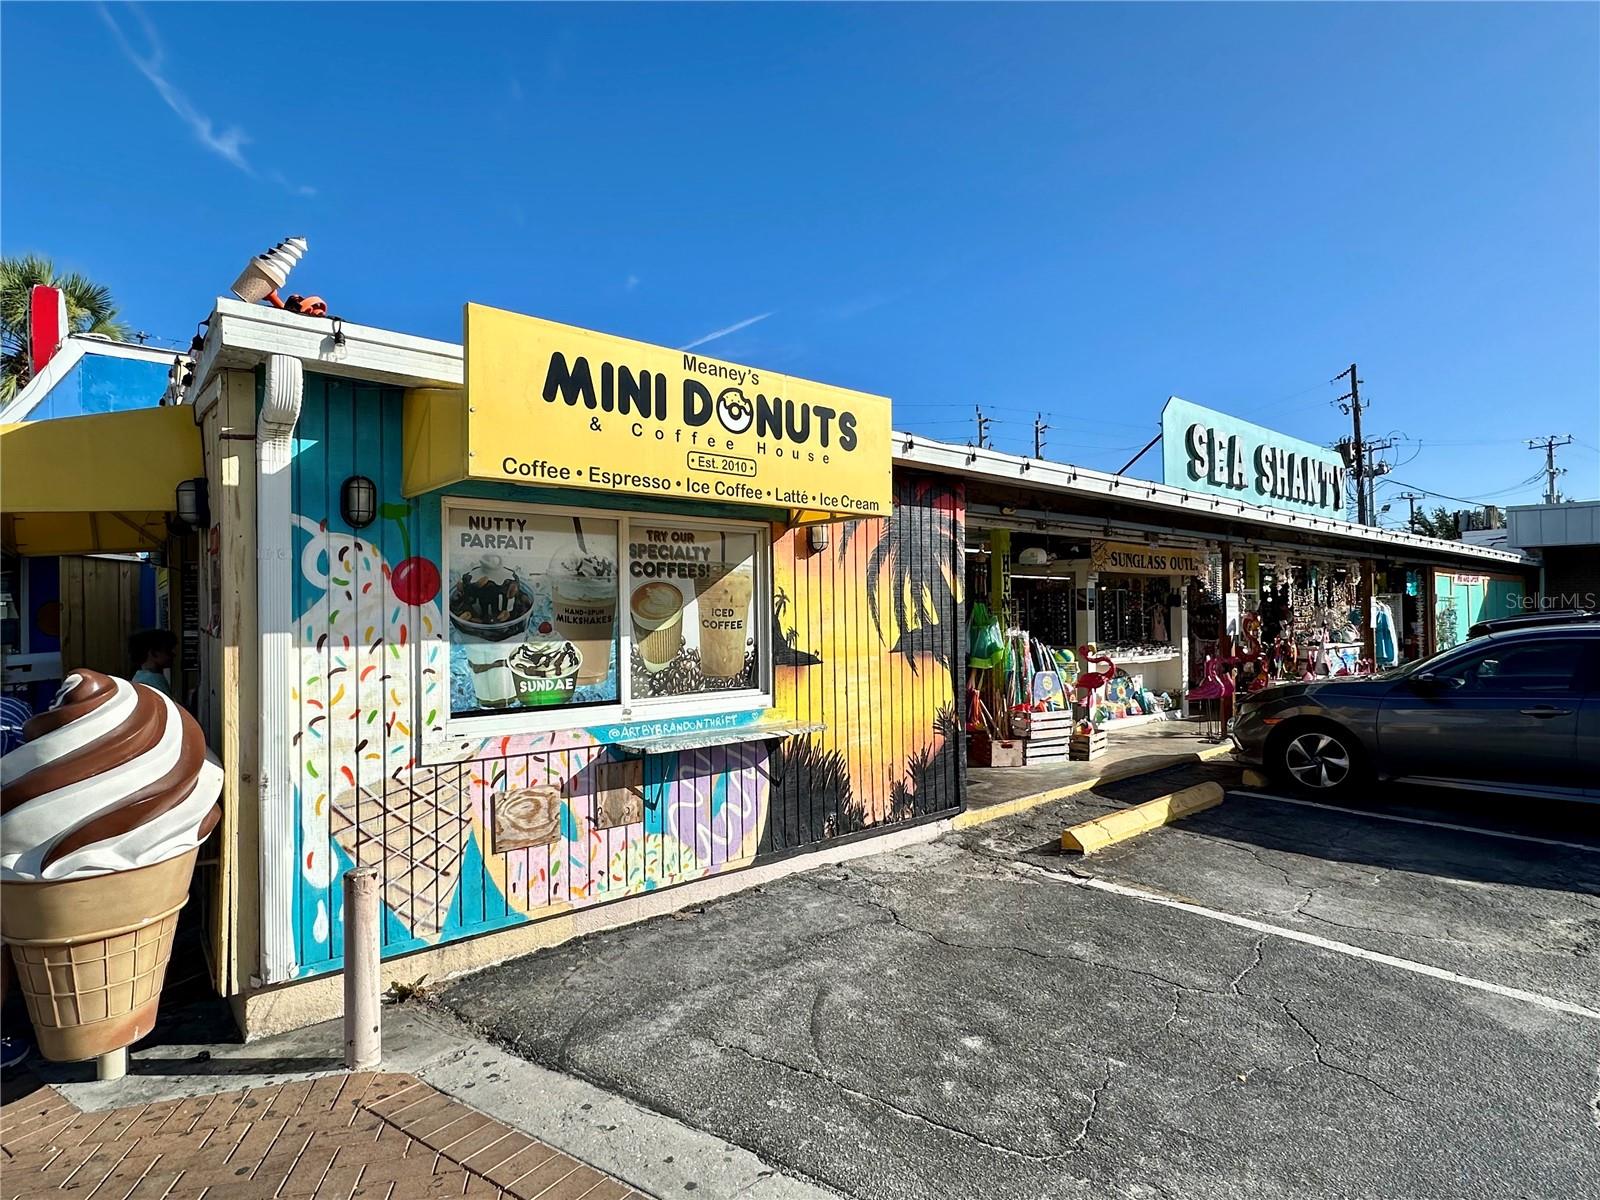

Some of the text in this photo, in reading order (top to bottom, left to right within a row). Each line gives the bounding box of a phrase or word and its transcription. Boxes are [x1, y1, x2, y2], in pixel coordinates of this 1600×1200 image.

[683, 354, 760, 385] Meaney's
[542, 351, 858, 451] MINI DONUTS
[590, 416, 830, 464] & Coffee House
[698, 456, 747, 473] Est. 2010
[1185, 423, 1346, 511] SEA SHANTY
[502, 457, 880, 511] Coffee Espresso Ice Coffee Latté Ice Cream
[468, 515, 527, 533] NUTTY
[460, 532, 535, 550] PARFAIT
[646, 530, 695, 544] TRY OUR
[629, 543, 711, 561] SPECIALTY
[629, 561, 710, 579] COFFEES!
[1110, 552, 1199, 571] SUNGLASS OUTL
[556, 614, 612, 625] MILKSHAKES
[564, 607, 605, 616] HAND-SPUN
[711, 608, 734, 618] ICED
[702, 619, 743, 630] COFFEE
[519, 677, 574, 693] SUNDAE
